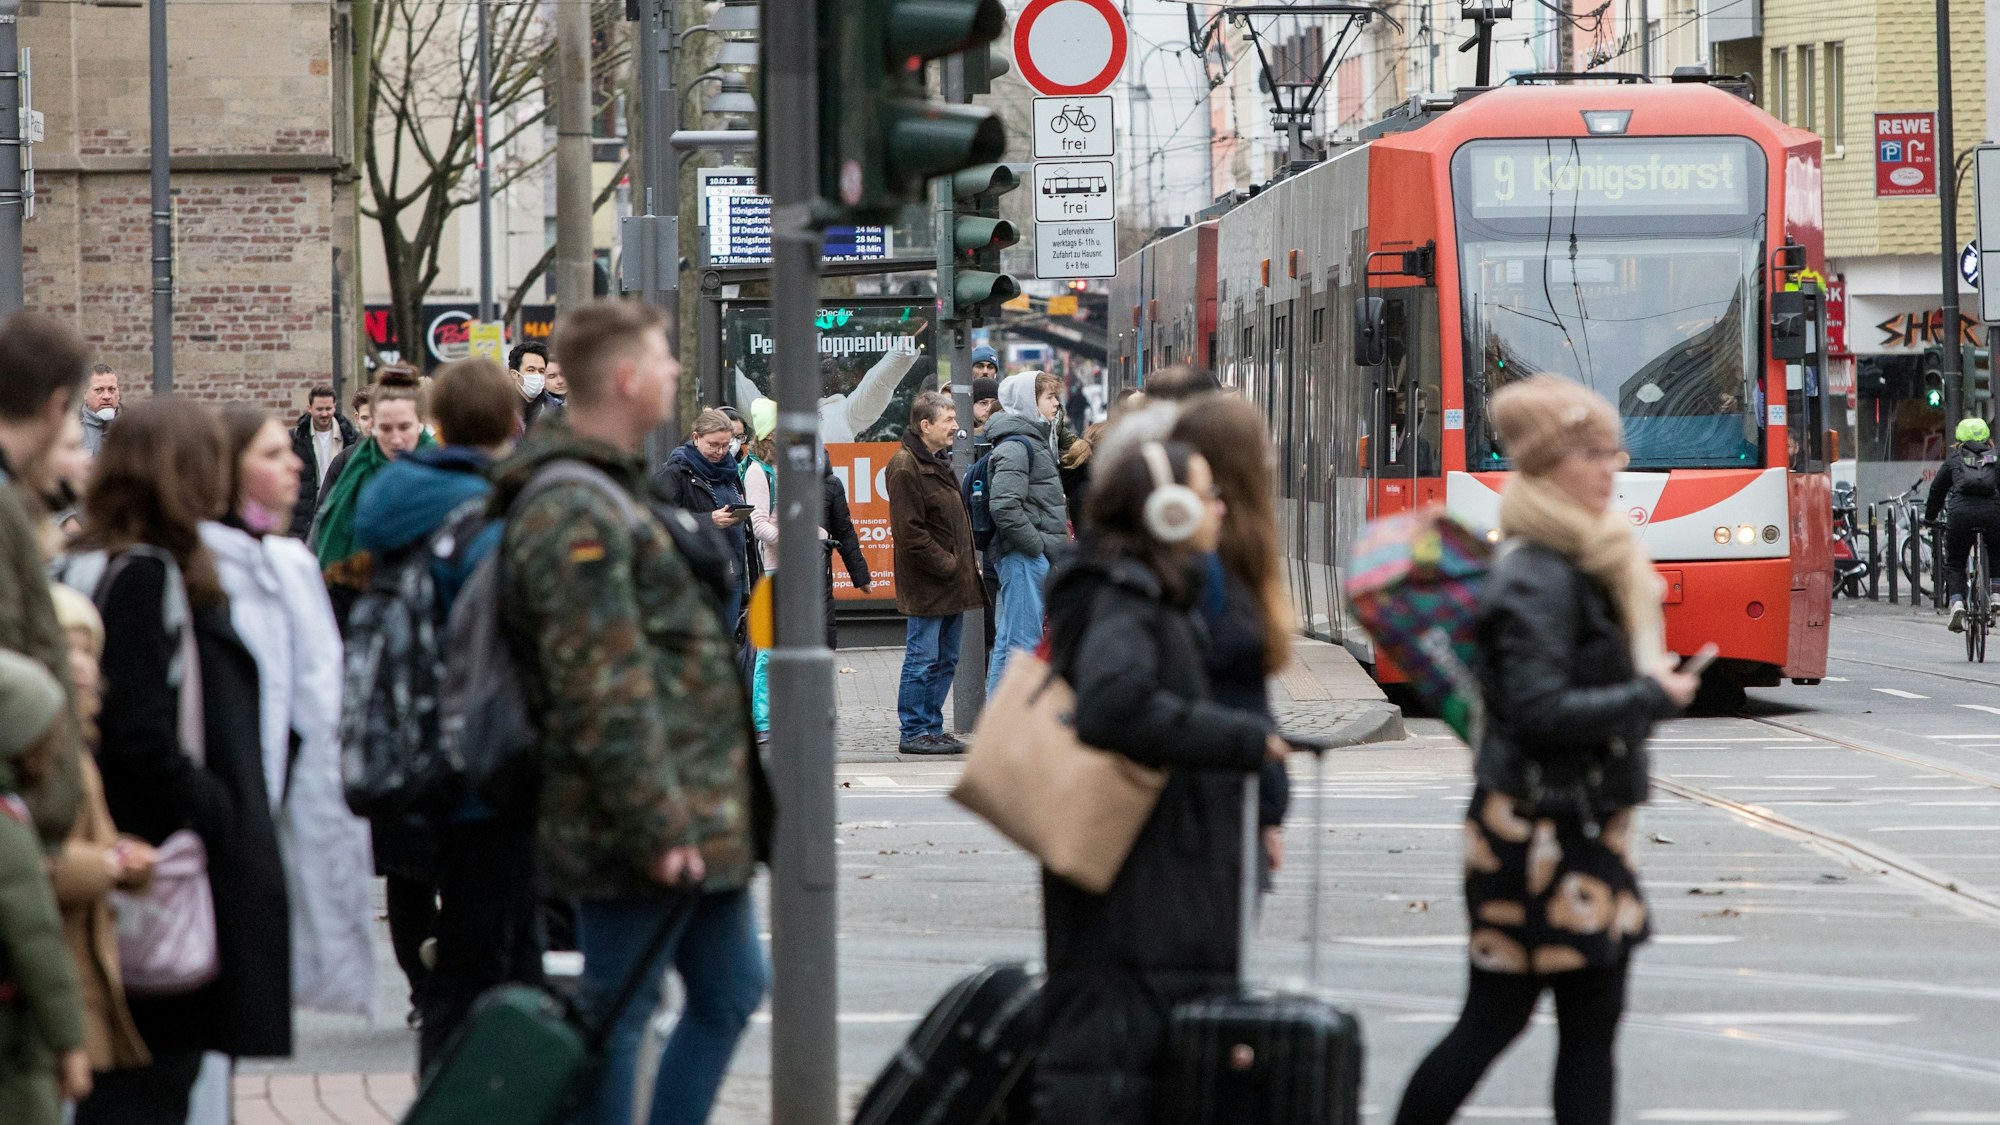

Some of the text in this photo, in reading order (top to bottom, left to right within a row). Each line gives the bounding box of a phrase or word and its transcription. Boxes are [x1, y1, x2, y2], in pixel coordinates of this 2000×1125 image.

[1879, 119, 1931, 134] REWE
[1062, 137, 1087, 150] frei
[1886, 146, 1898, 161] P
[1494, 152, 1734, 201] 9 Königsforst
[741, 197, 774, 205] Deutz/M
[731, 207, 771, 216] Königsforst
[1063, 201, 1088, 214] frei
[731, 217, 771, 225] Königsforst
[731, 226, 740, 234] Bf
[741, 226, 774, 235] Deutz/M
[1057, 227, 1095, 237] Lieferverkehr
[731, 236, 771, 245] Königsforst
[1052, 238, 1077, 249] werktags
[1085, 238, 1095, 247] 11h
[731, 246, 772, 255] Königsforst
[1052, 251, 1073, 260] Zufahrt
[1081, 250, 1104, 259] Hausnr.
[1080, 260, 1090, 269] frei
[815, 309, 854, 318] CDecaux
[817, 331, 916, 358] loppenburg
[837, 571, 851, 579] Sto
[870, 570, 894, 578] Onlin
